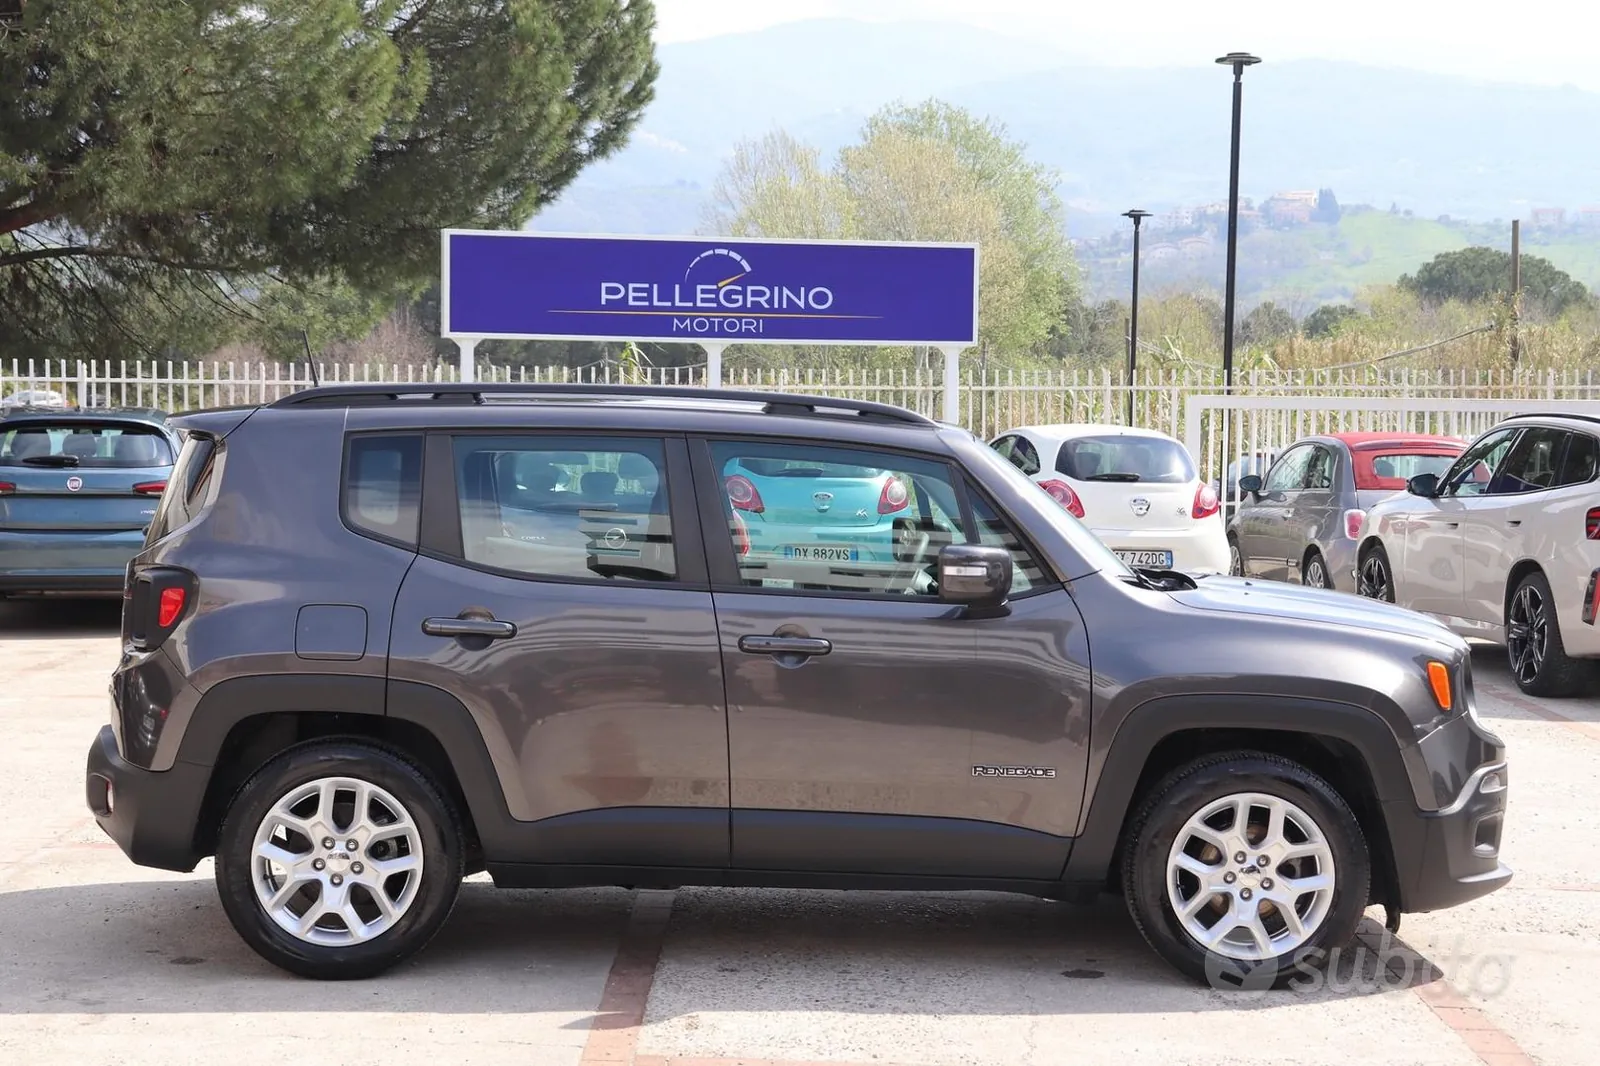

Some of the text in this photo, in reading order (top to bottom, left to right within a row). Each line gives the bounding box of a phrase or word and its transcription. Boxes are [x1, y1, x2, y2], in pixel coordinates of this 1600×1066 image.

[600, 282, 834, 309] PELLEGRINO
[672, 317, 764, 333] MOTORI
[813, 548, 849, 561] 882VS
[1130, 552, 1165, 565] 742DG
[972, 765, 1056, 778] RENEGADE
